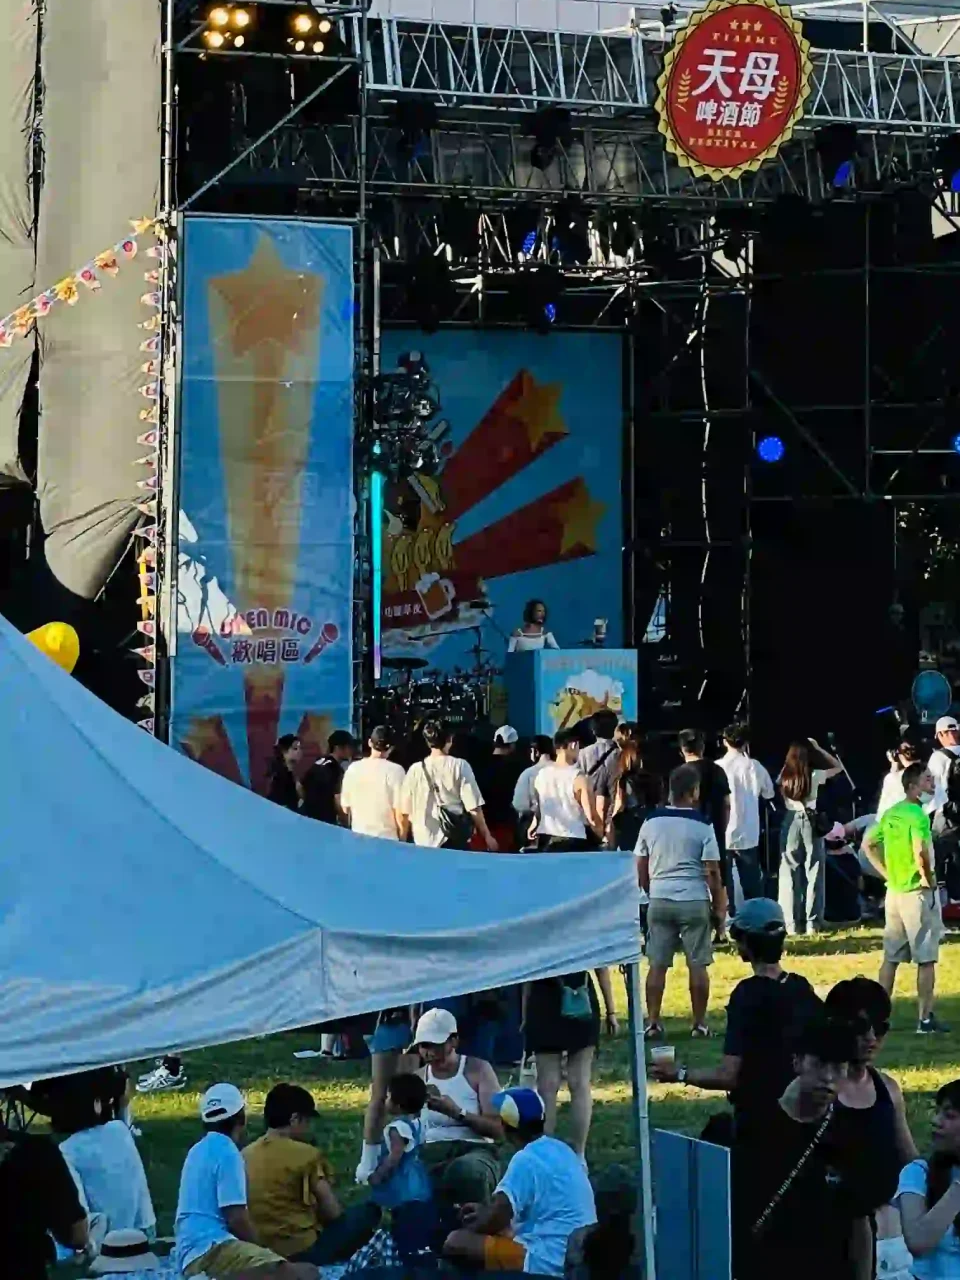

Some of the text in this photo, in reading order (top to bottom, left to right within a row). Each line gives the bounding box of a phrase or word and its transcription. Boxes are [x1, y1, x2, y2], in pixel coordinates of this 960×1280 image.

[691, 48, 780, 100] 天母
[695, 99, 763, 127] 啤酒節
